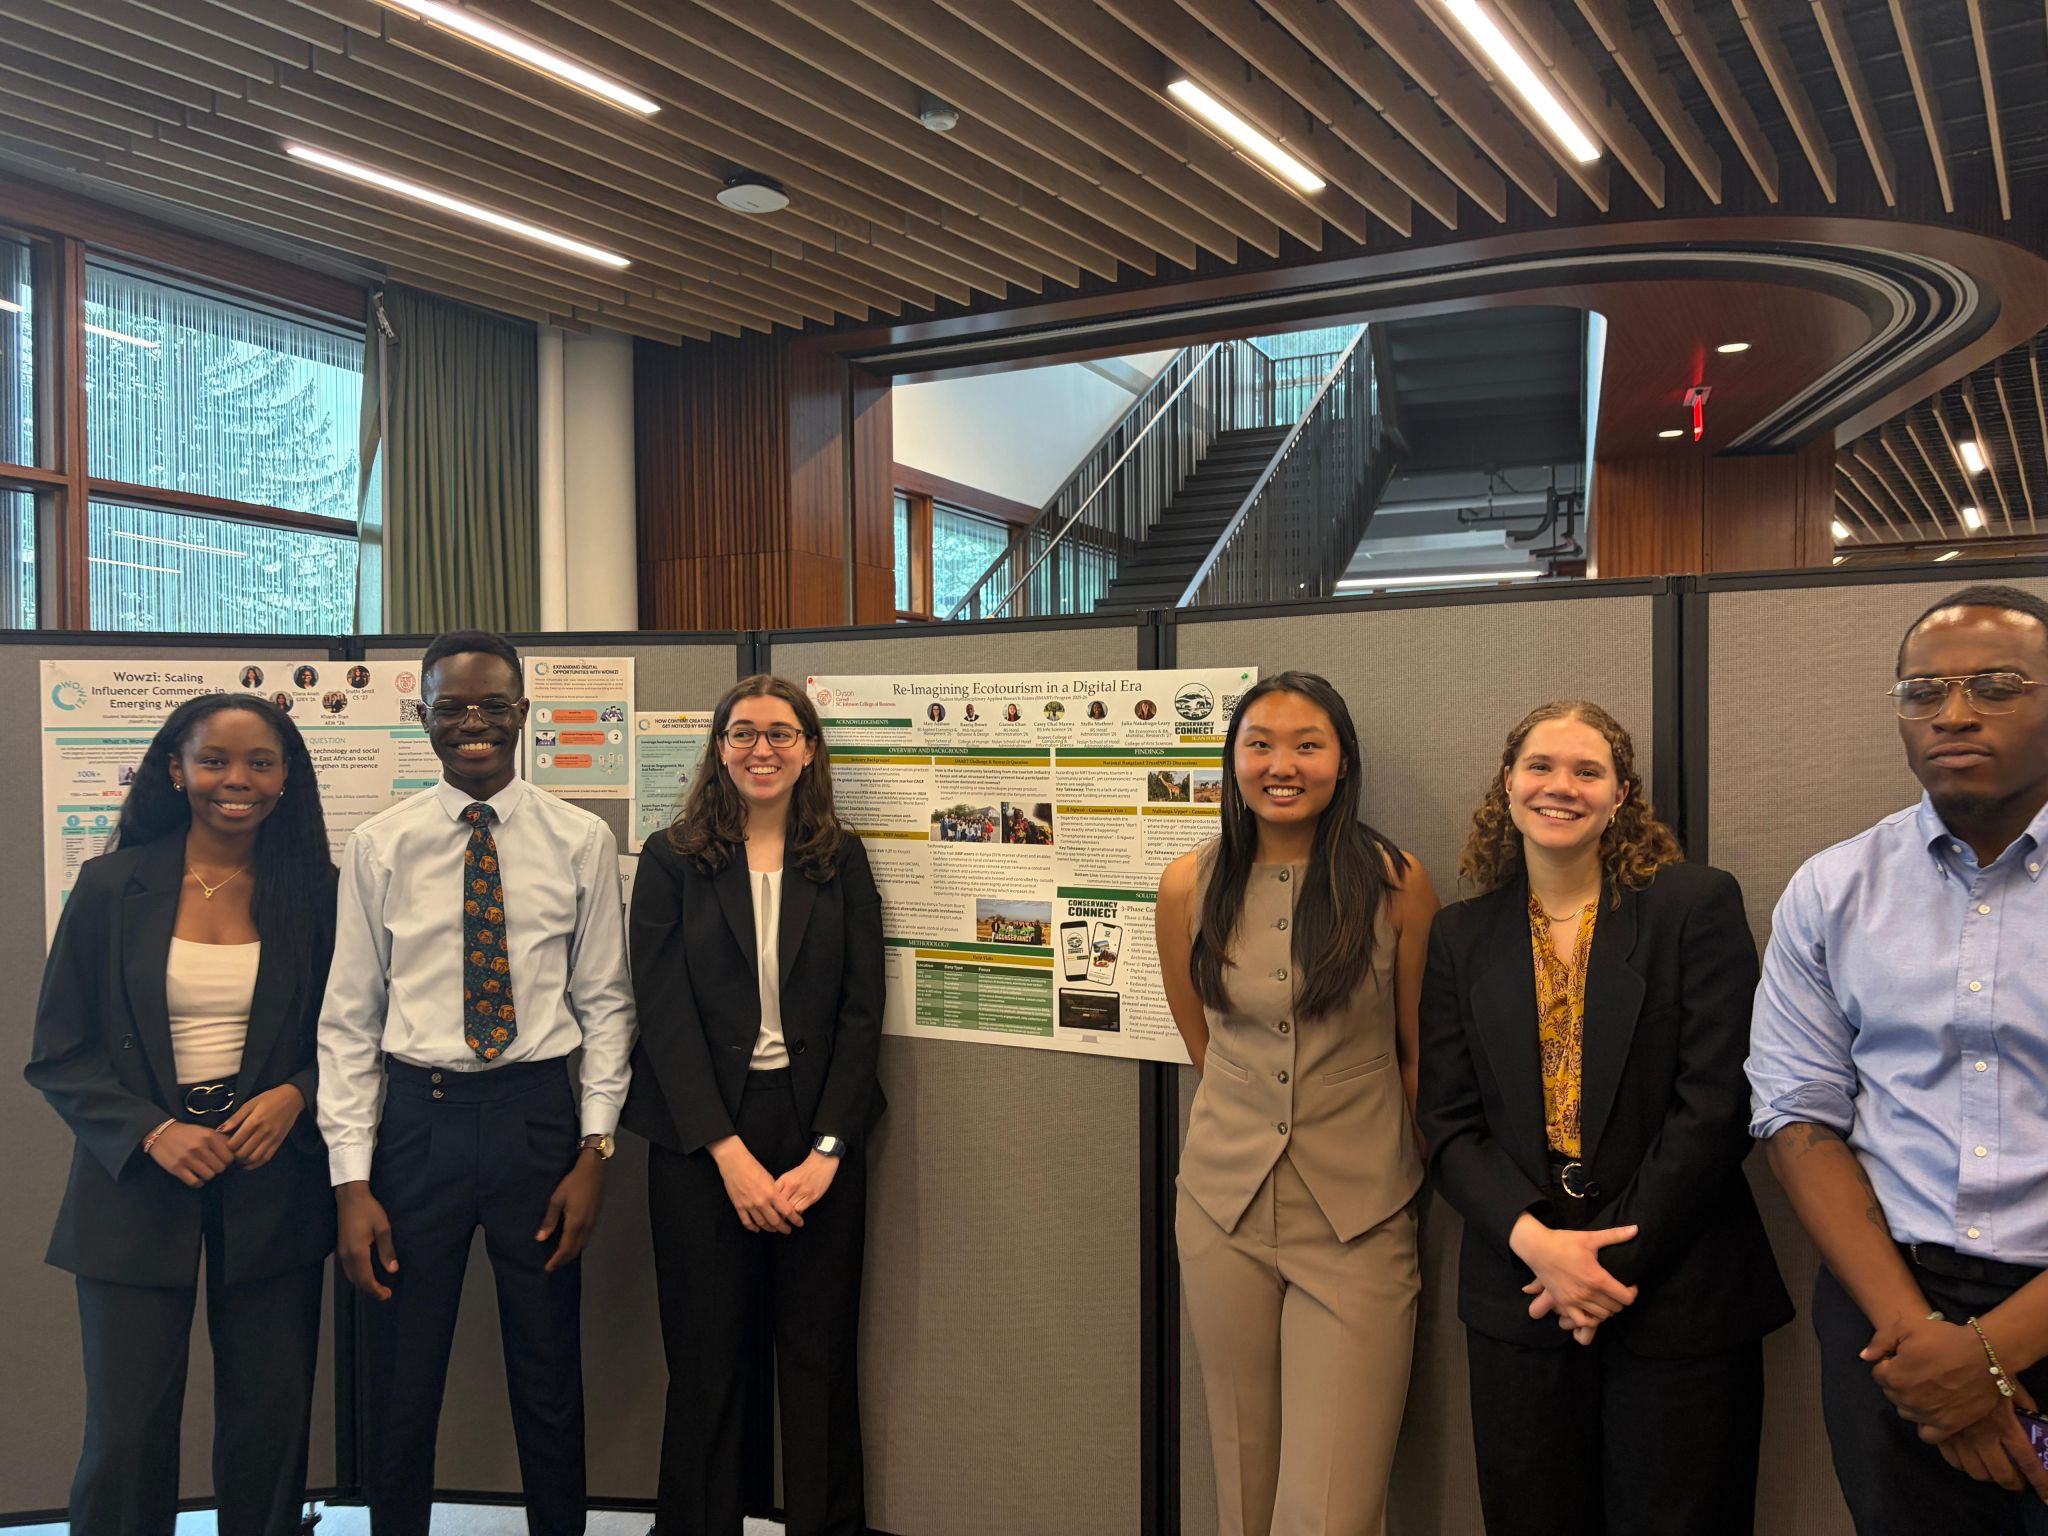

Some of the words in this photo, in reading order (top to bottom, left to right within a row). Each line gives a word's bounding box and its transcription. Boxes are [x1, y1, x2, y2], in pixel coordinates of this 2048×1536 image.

[165, 673, 204, 685] Scaling
[91, 686, 150, 696] Influencer
[893, 683, 969, 698] Re-Imagining
[973, 682, 1042, 695] Ecotourism
[1046, 681, 1058, 693] in
[1073, 680, 1116, 696] Digital
[1120, 679, 1142, 692] Era
[110, 700, 162, 710] Emerging
[1175, 727, 1215, 735] CONNECT
[1068, 900, 1118, 908] CONSERVANCY
[1068, 907, 1118, 919] CONNECT
